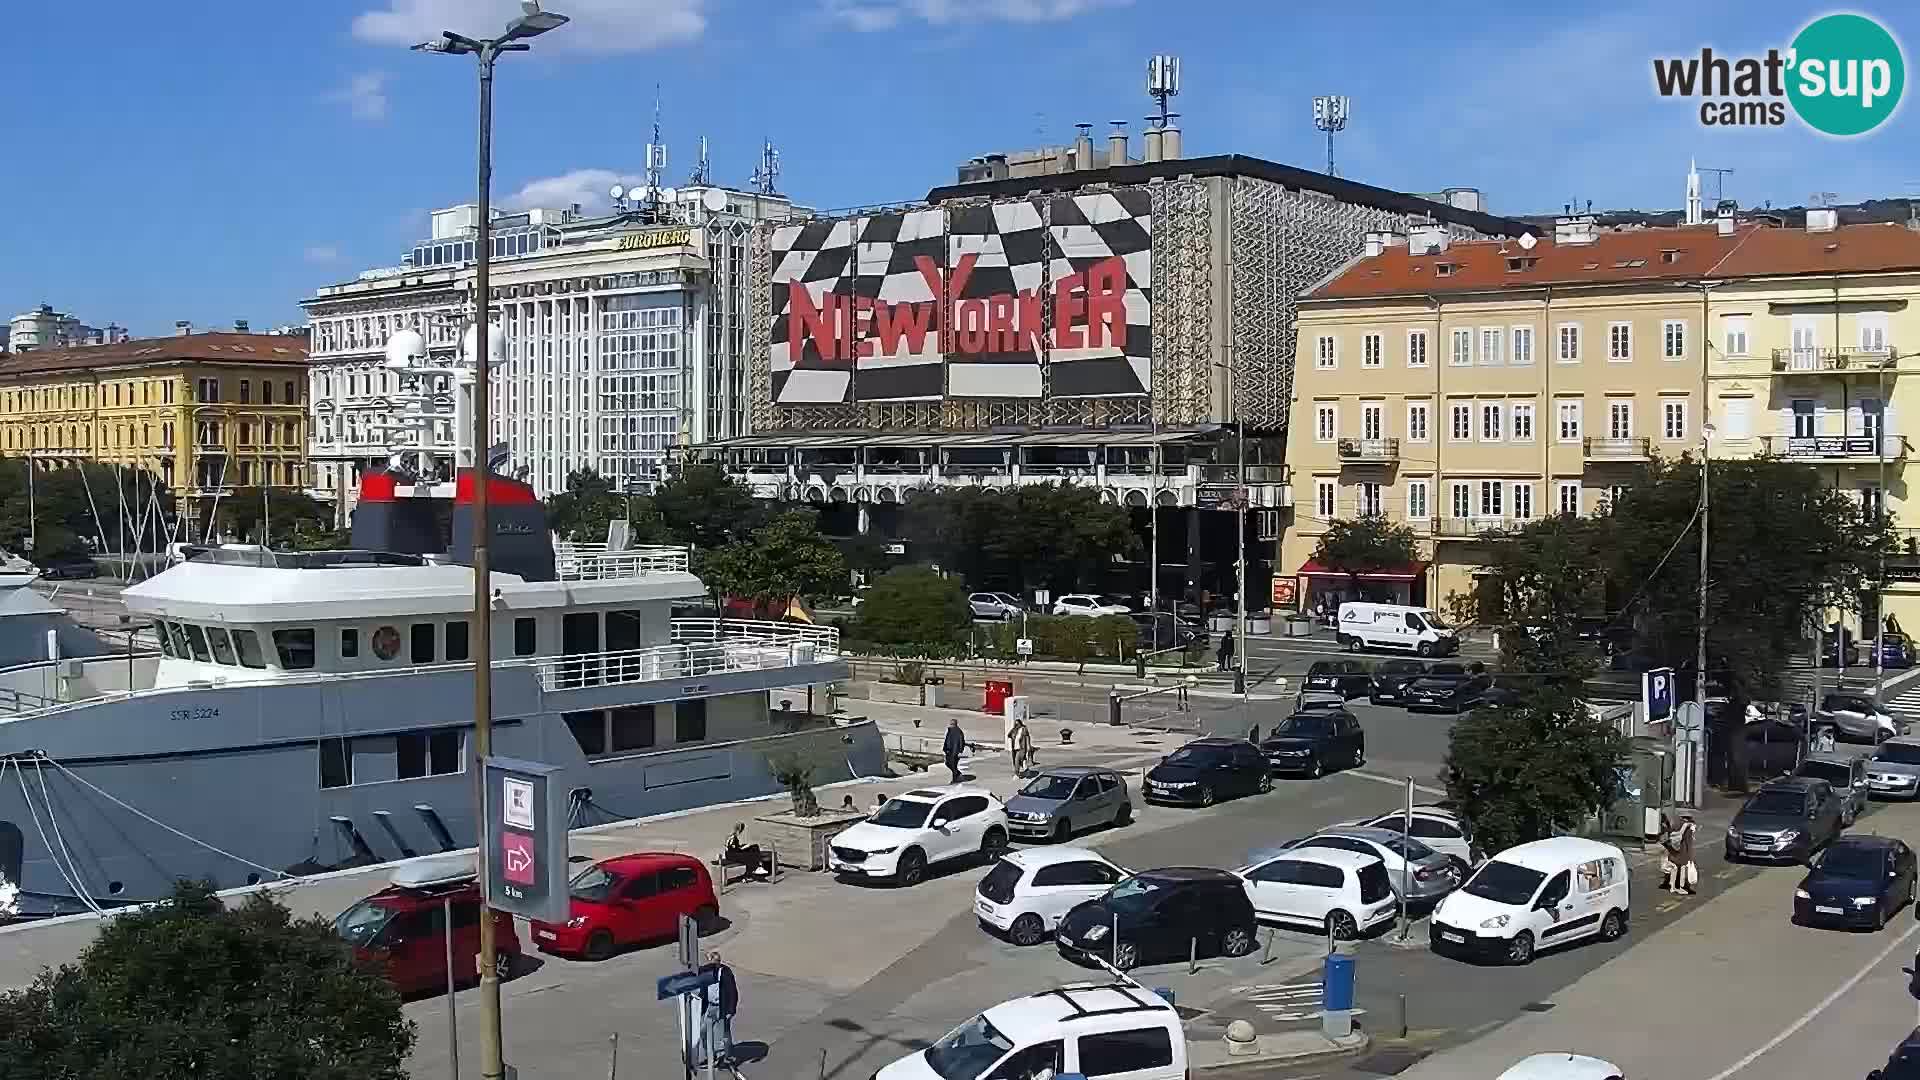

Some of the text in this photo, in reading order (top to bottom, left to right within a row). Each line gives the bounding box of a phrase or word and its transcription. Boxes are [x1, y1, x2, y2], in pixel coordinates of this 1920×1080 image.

[788, 252, 1128, 361] NEW YORKER
[1654, 675, 1666, 699] P
